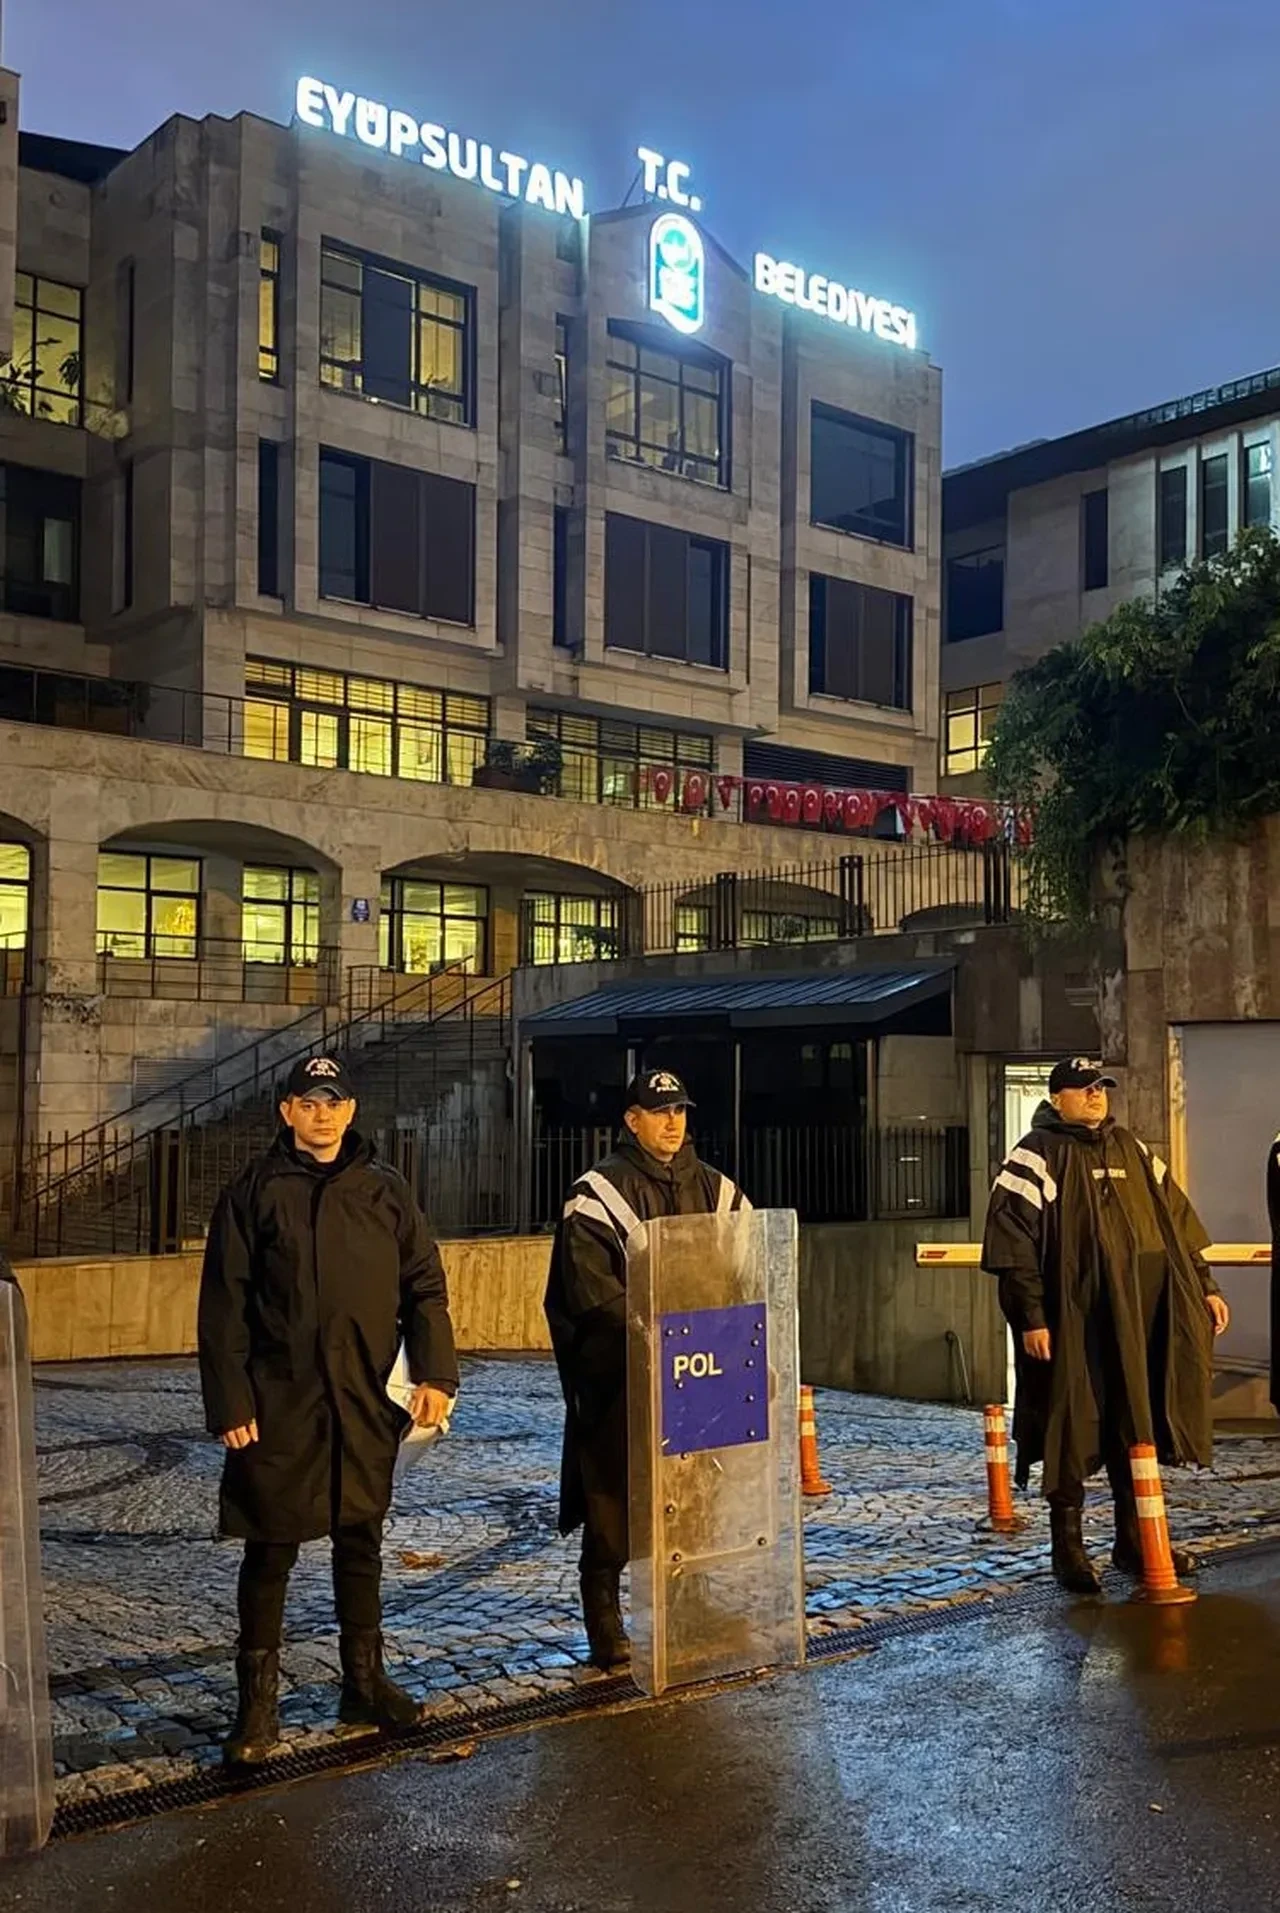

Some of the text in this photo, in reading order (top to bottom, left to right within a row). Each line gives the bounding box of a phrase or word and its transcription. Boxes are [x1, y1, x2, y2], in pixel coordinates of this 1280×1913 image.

[296, 76, 584, 220] EYÜPSULTAN
[637, 147, 702, 211] T.C.
[673, 1352, 723, 1380] POL
